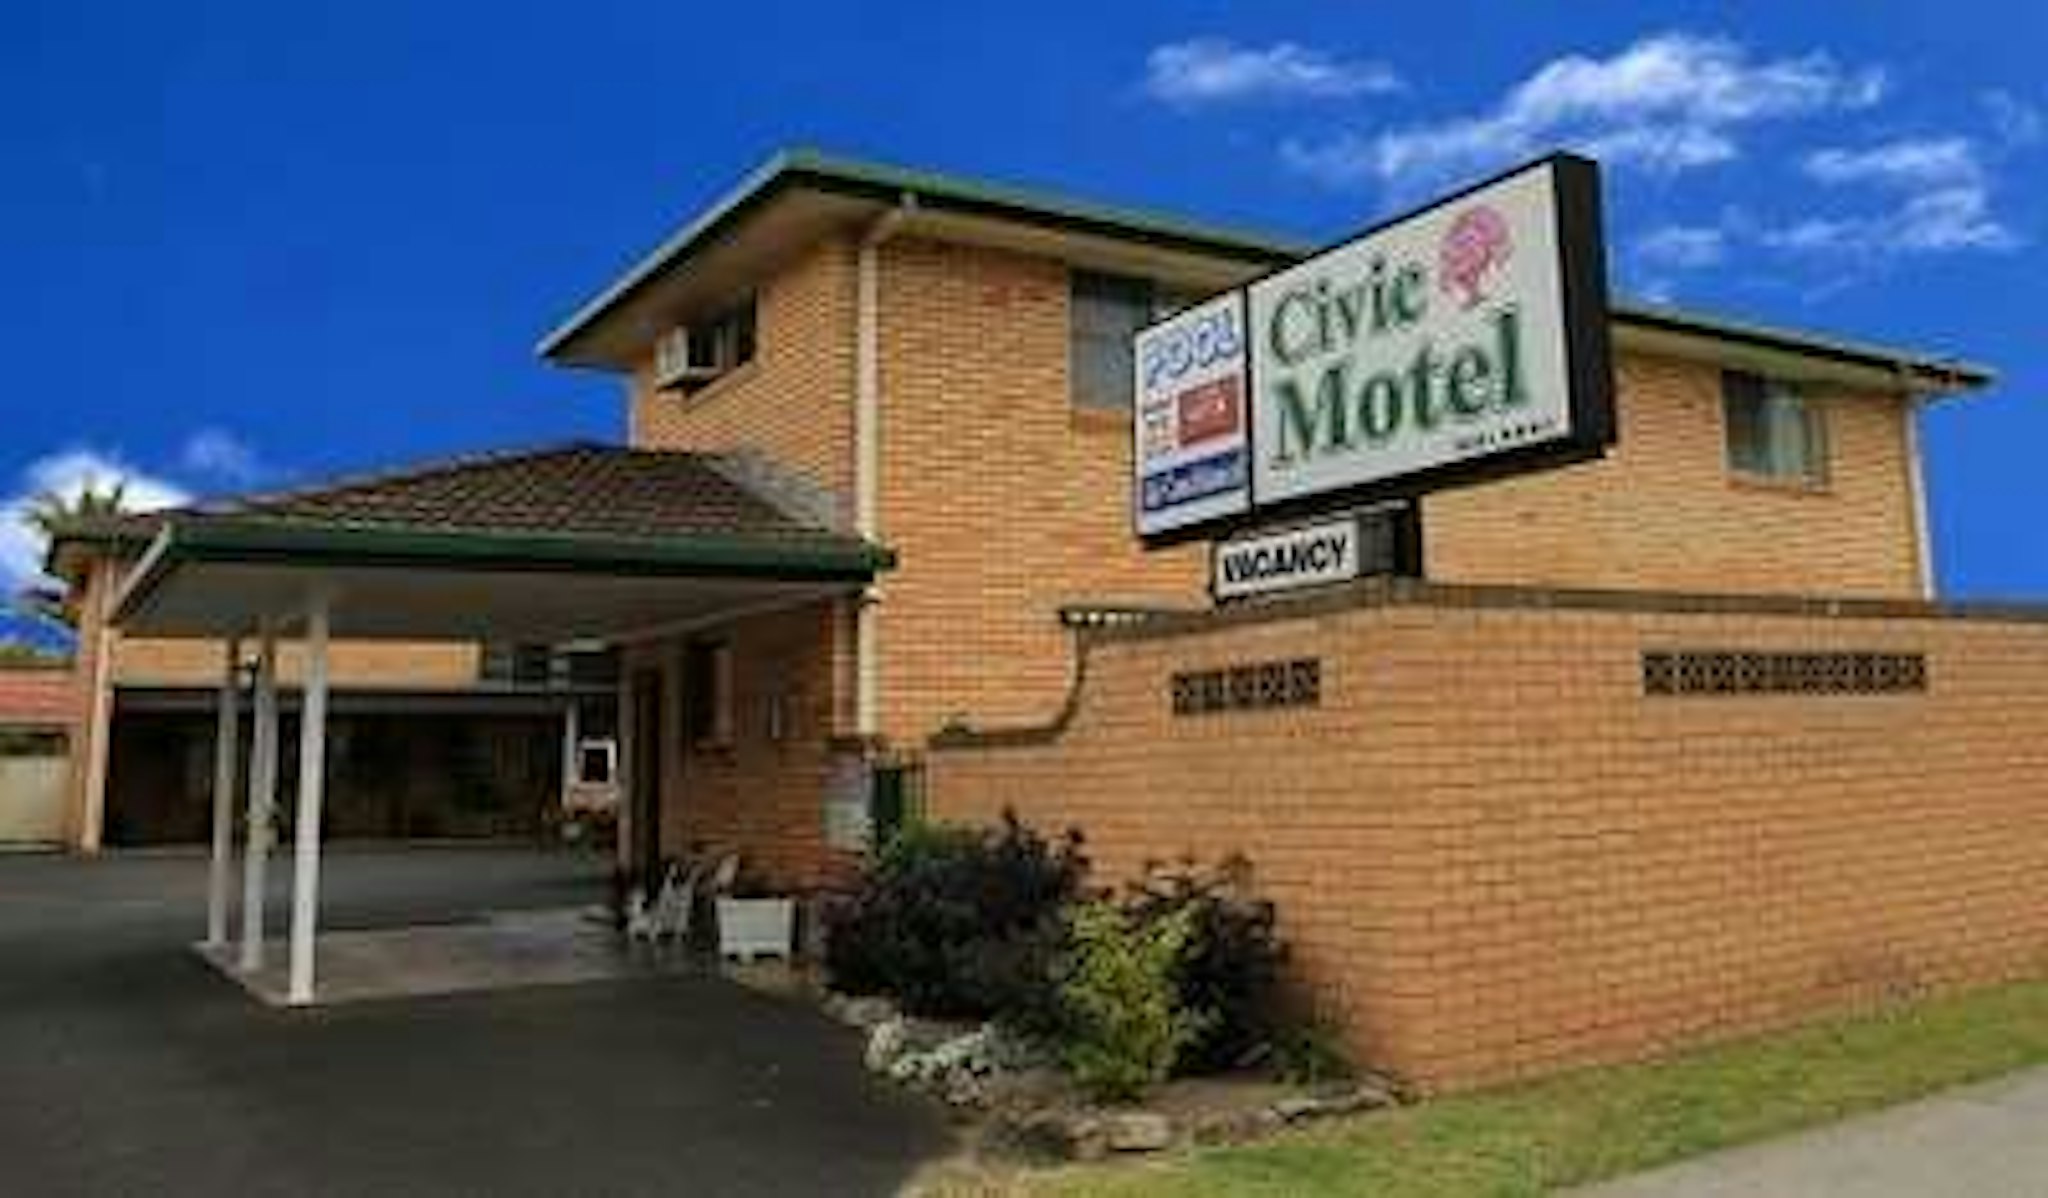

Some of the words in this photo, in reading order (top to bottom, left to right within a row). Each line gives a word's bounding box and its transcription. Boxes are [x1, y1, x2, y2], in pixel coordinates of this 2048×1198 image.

[1143, 309, 1239, 388] POOL
[1269, 260, 1427, 367] Civic
[1269, 310, 1530, 468] Motel
[1223, 533, 1348, 583] VACANCY
